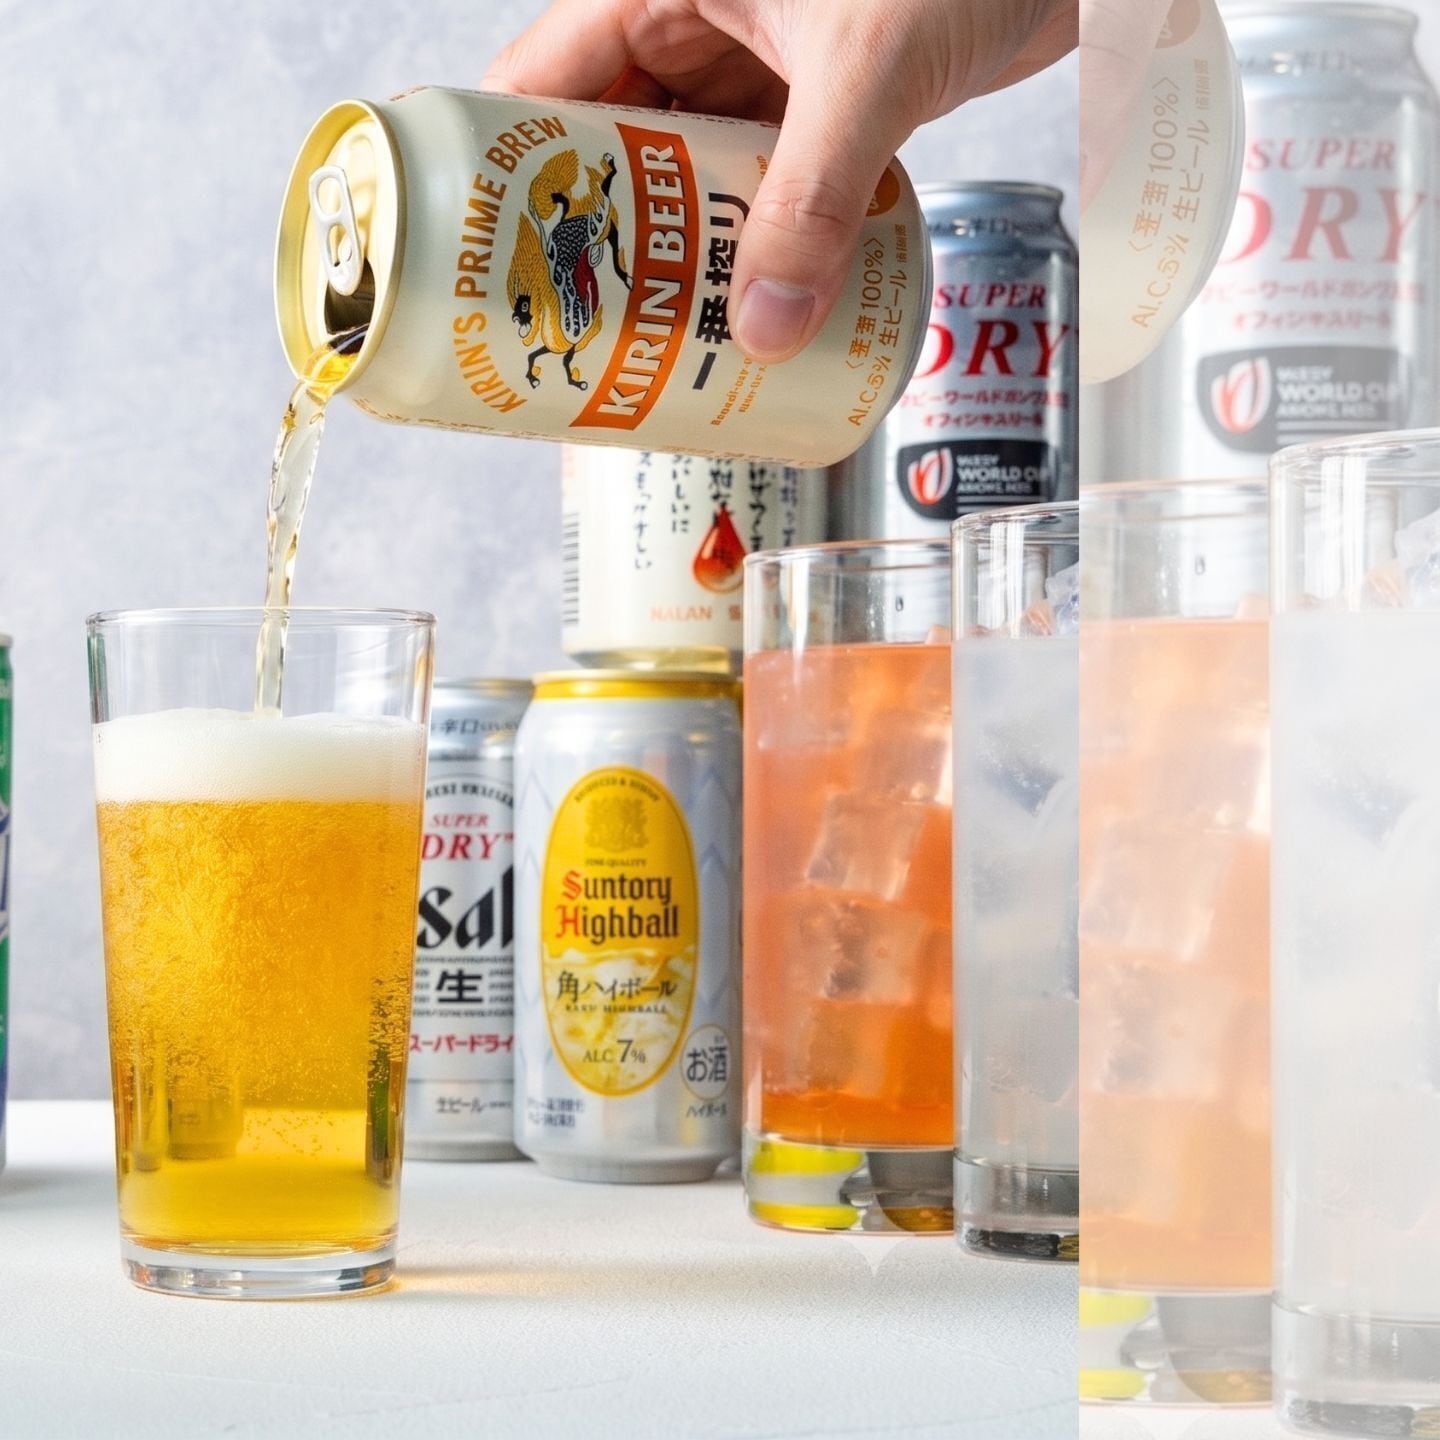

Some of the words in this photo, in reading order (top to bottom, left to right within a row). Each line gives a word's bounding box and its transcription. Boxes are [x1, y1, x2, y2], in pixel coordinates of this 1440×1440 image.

[485, 116, 568, 175] BREW
[1246, 137, 1396, 173] SUPER
[454, 172, 507, 298] PRIME
[596, 277, 681, 416] KIRIN
[640, 143, 687, 263] BEER
[935, 282, 1046, 309] SUPER
[452, 311, 528, 414] KIRIN'S
[430, 814, 490, 828] SUPER
[421, 833, 500, 861] DRY
[562, 869, 672, 906] Suntory
[555, 904, 679, 946] Highball
[436, 968, 484, 1004] 生
[557, 970, 678, 1003] 角ハイボール
[582, 1048, 614, 1064] ALC
[616, 1039, 646, 1064] 7%
[686, 1046, 728, 1082] お酒
